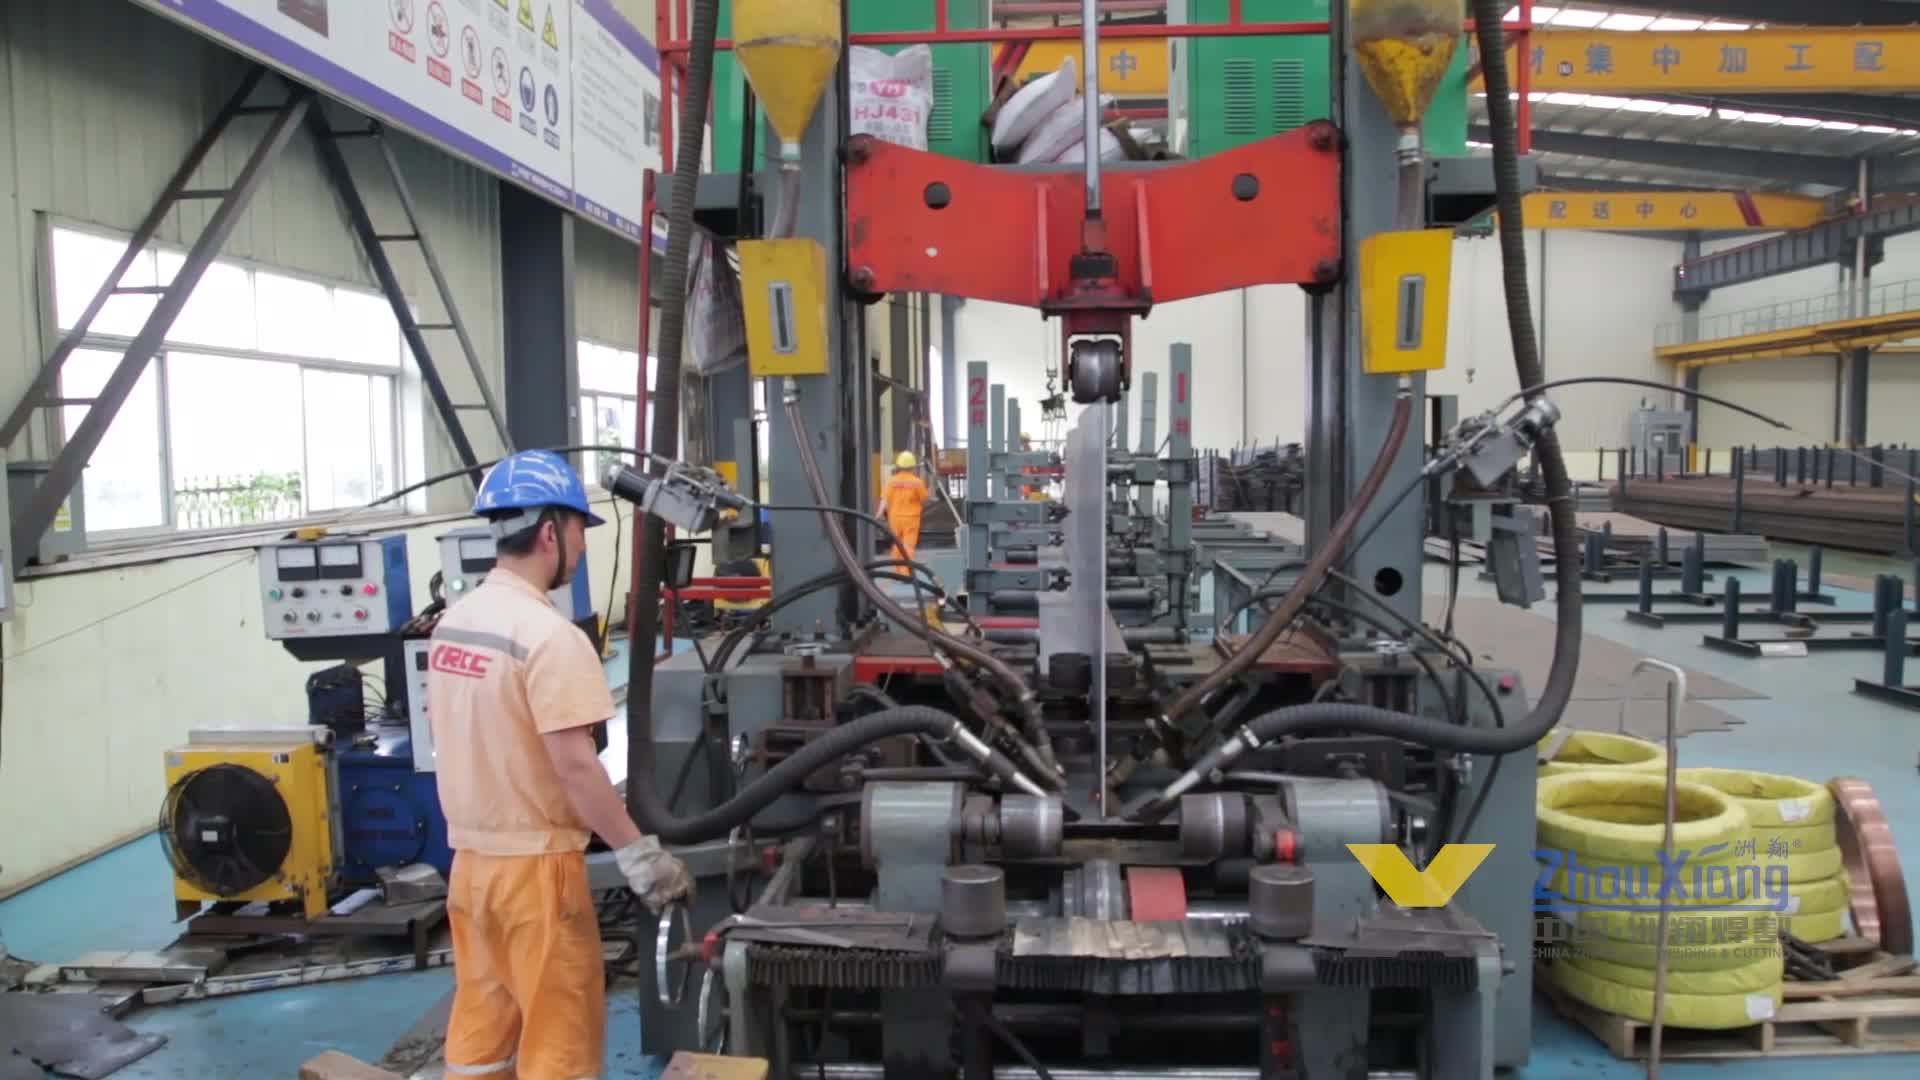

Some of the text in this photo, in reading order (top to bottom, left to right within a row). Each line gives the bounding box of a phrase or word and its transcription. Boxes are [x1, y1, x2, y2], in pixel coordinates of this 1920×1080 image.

[1110, 48, 1137, 80] 中
[1551, 200, 1698, 220] 配送中心
